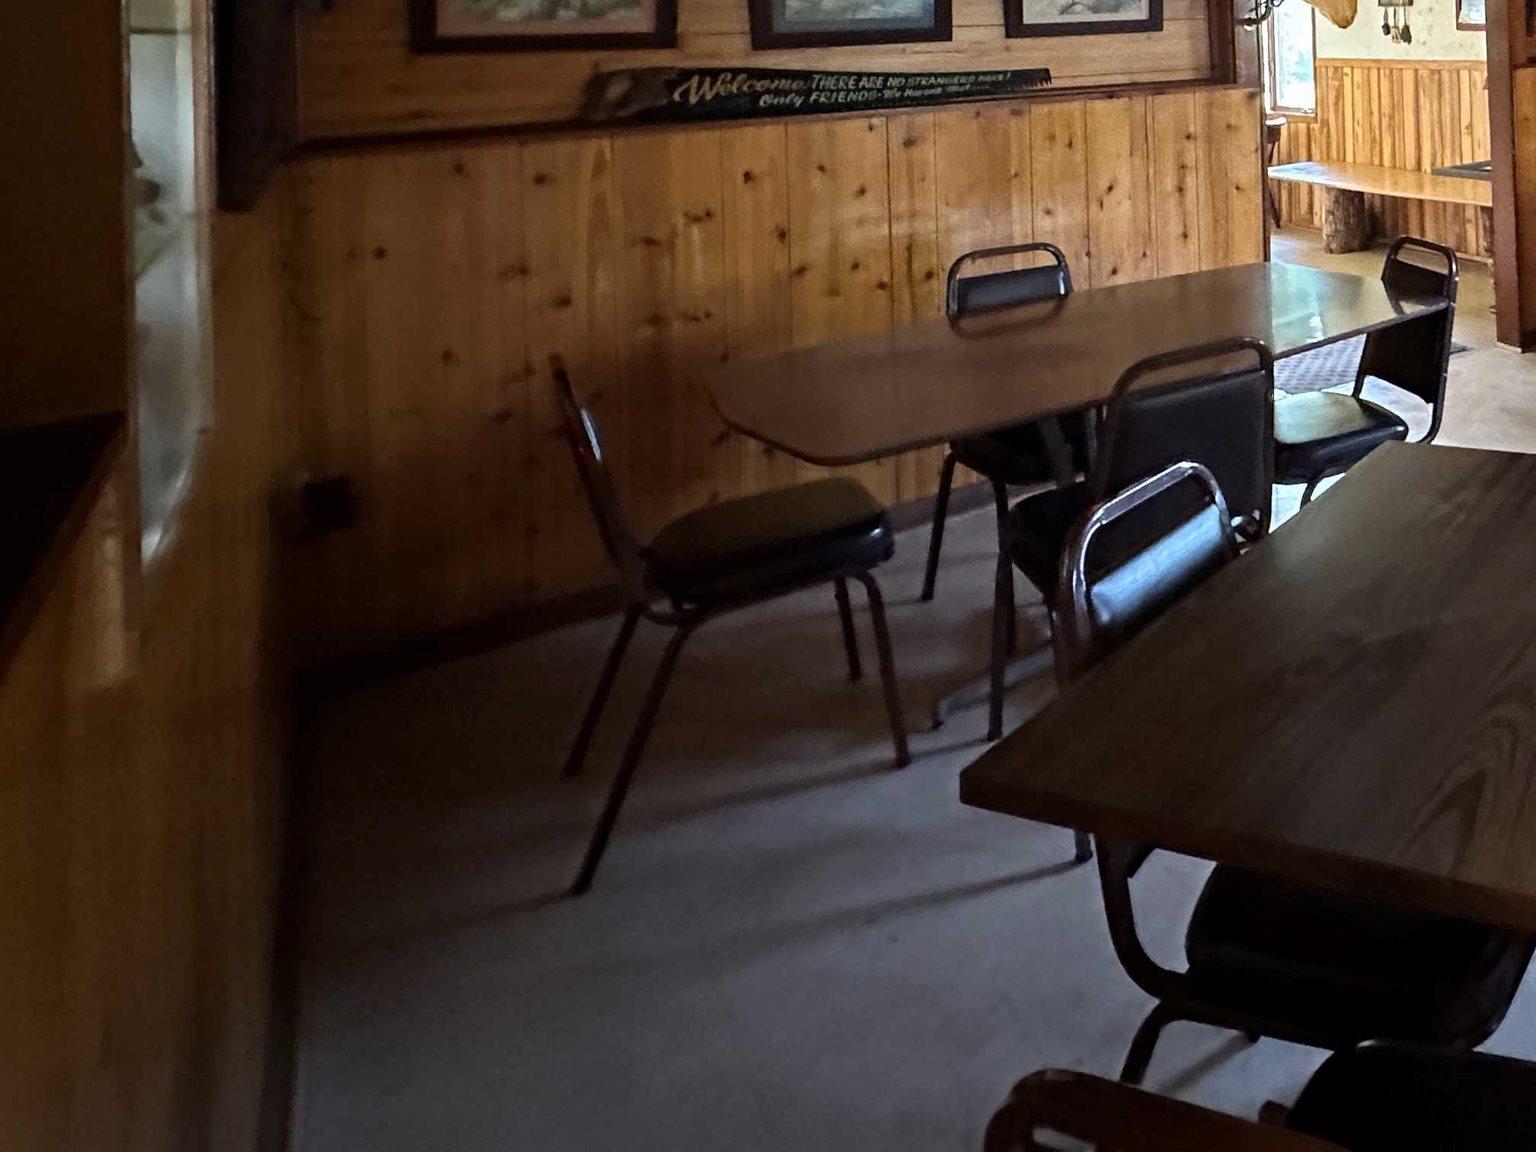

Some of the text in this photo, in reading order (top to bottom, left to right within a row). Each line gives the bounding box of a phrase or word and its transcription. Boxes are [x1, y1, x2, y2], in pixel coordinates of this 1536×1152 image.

[673, 72, 808, 105] Welcome
[811, 74, 858, 90] THERE
[859, 76, 885, 89] ARE
